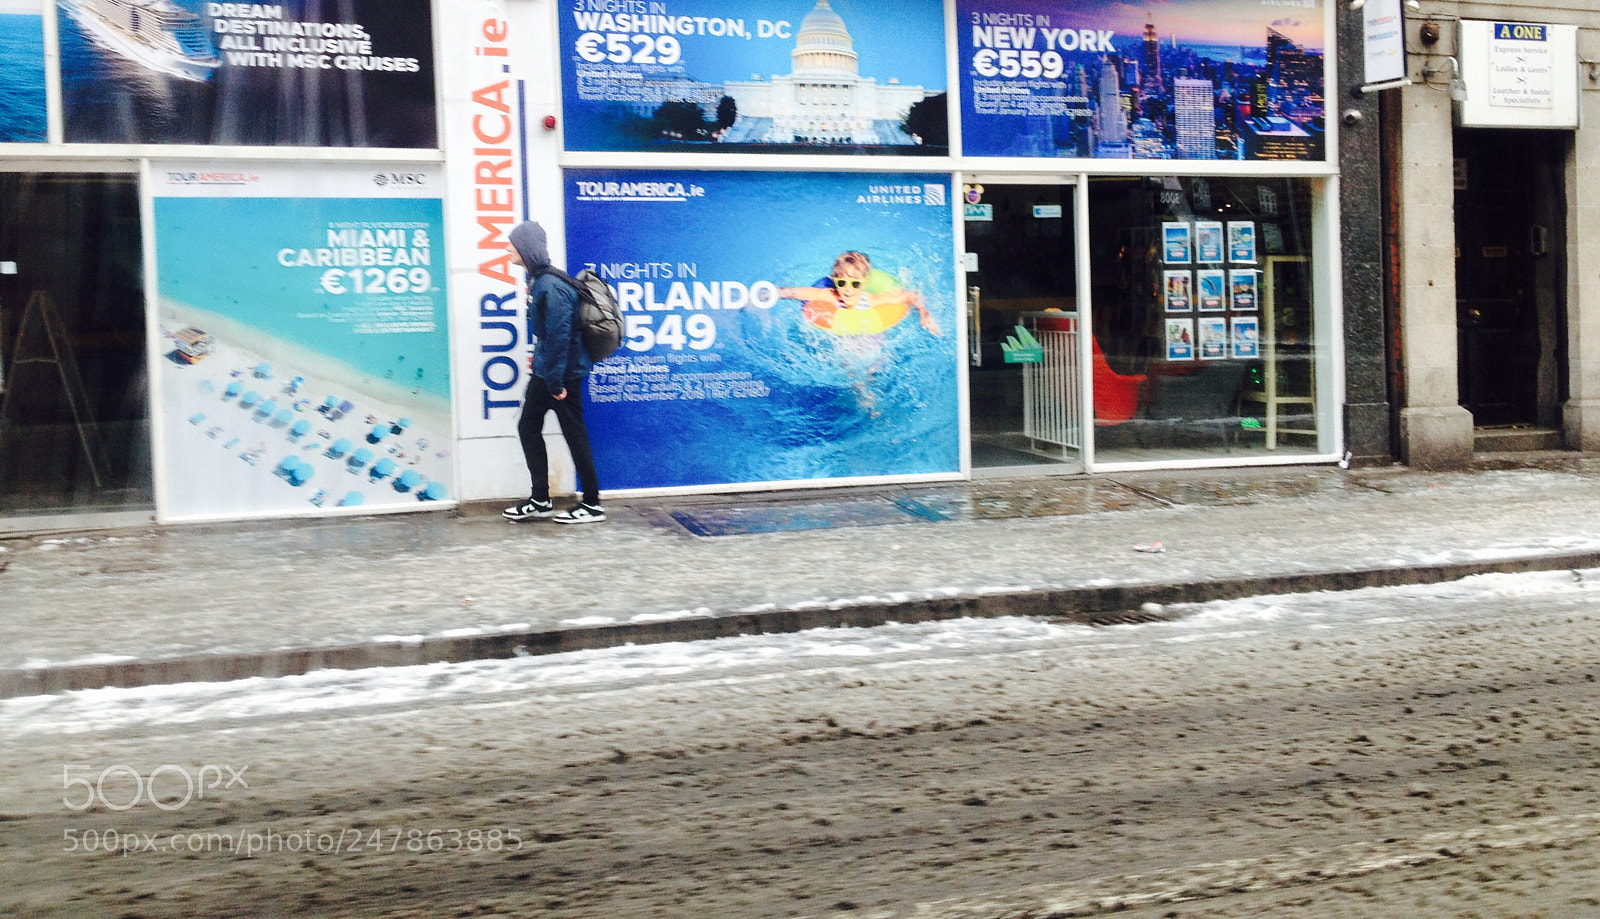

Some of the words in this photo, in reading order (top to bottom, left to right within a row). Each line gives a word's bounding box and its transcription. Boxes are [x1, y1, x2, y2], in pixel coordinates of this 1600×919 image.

[208, 3, 282, 19] DREAM
[573, 0, 585, 11] 3
[587, 0, 648, 14] NIGHTS
[649, 1, 666, 15] IN
[573, 11, 752, 40] WASHINGTON,
[757, 19, 792, 39] DC
[971, 11, 980, 25] 3
[983, 12, 1034, 27] NIGHTS
[1036, 14, 1050, 27] IN
[214, 19, 371, 40] DESTINATIONS,
[1500, 25, 1511, 38] A
[1513, 25, 1542, 39] ONE
[220, 35, 261, 51] ALL
[264, 37, 373, 55] INCLUSIVE
[972, 26, 1036, 49] NEW
[1040, 28, 1116, 52] YORK
[575, 32, 682, 65] €529
[226, 52, 283, 67] WITH
[286, 54, 331, 69] MSC
[334, 55, 420, 72] CRUISES
[972, 49, 1064, 79] €559
[576, 69, 608, 78] United
[609, 70, 643, 80] Airlines
[973, 86, 1000, 94] United
[391, 173, 426, 184] MSC
[868, 185, 922, 194] UNITED
[856, 195, 922, 204] AIRLINES
[327, 229, 406, 247] MIAMI
[411, 229, 430, 247] &
[277, 248, 431, 267] CARIBBEAN
[601, 263, 673, 279] NIGHTS
[677, 263, 697, 279] IN
[320, 267, 432, 294] €1269
[608, 280, 779, 311] RLANDO
[621, 313, 717, 352] 549
[634, 355, 666, 364] return
[666, 353, 698, 365] flights
[699, 353, 722, 362] with
[627, 364, 670, 374] Airlines
[588, 374, 598, 384] &
[600, 374, 607, 384] 7
[608, 374, 641, 385] nights
[641, 372, 670, 382] hotel
[589, 382, 623, 393] Based
[624, 384, 640, 392] on
[640, 382, 649, 392] 2
[622, 391, 679, 401] November
